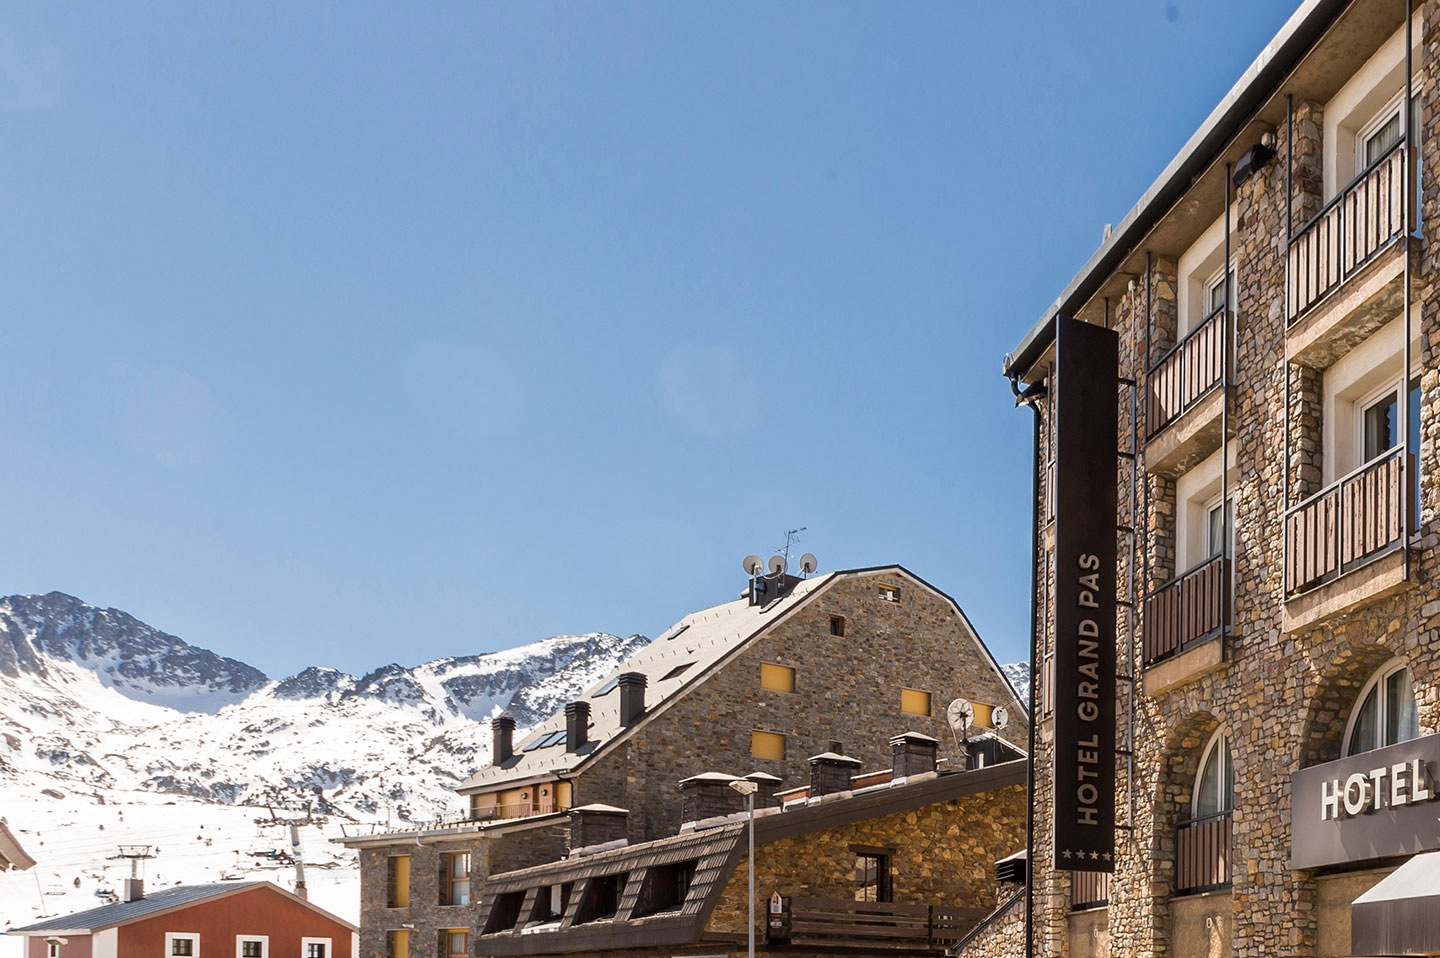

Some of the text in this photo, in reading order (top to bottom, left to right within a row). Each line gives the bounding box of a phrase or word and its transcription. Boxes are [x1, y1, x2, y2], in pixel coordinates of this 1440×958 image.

[1077, 552, 1101, 826] HOTEL GRAND PAS
[1320, 758, 1431, 821] HOTEL
